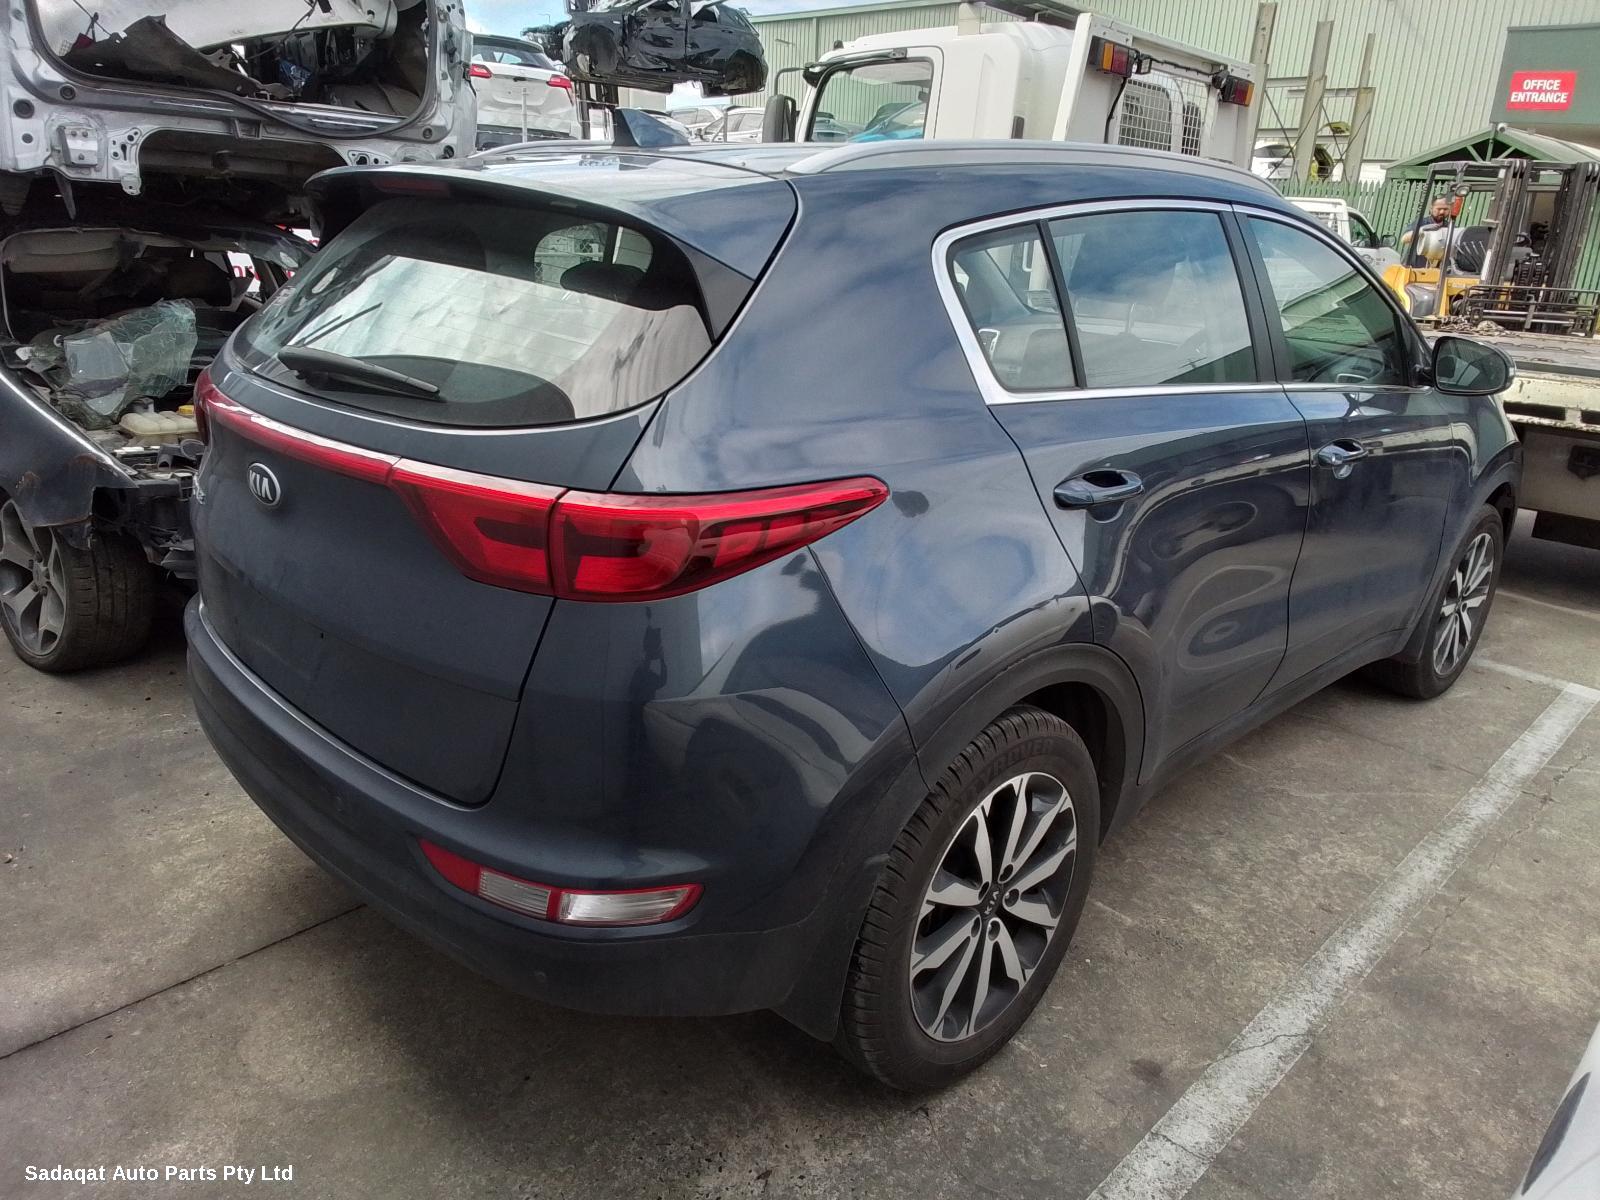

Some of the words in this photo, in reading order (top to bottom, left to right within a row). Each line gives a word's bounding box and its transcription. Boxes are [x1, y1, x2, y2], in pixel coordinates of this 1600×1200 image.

[1523, 80, 1560, 91] OFFICE
[1511, 92, 1568, 103] ENTRANCE
[249, 469, 273, 501] KIA
